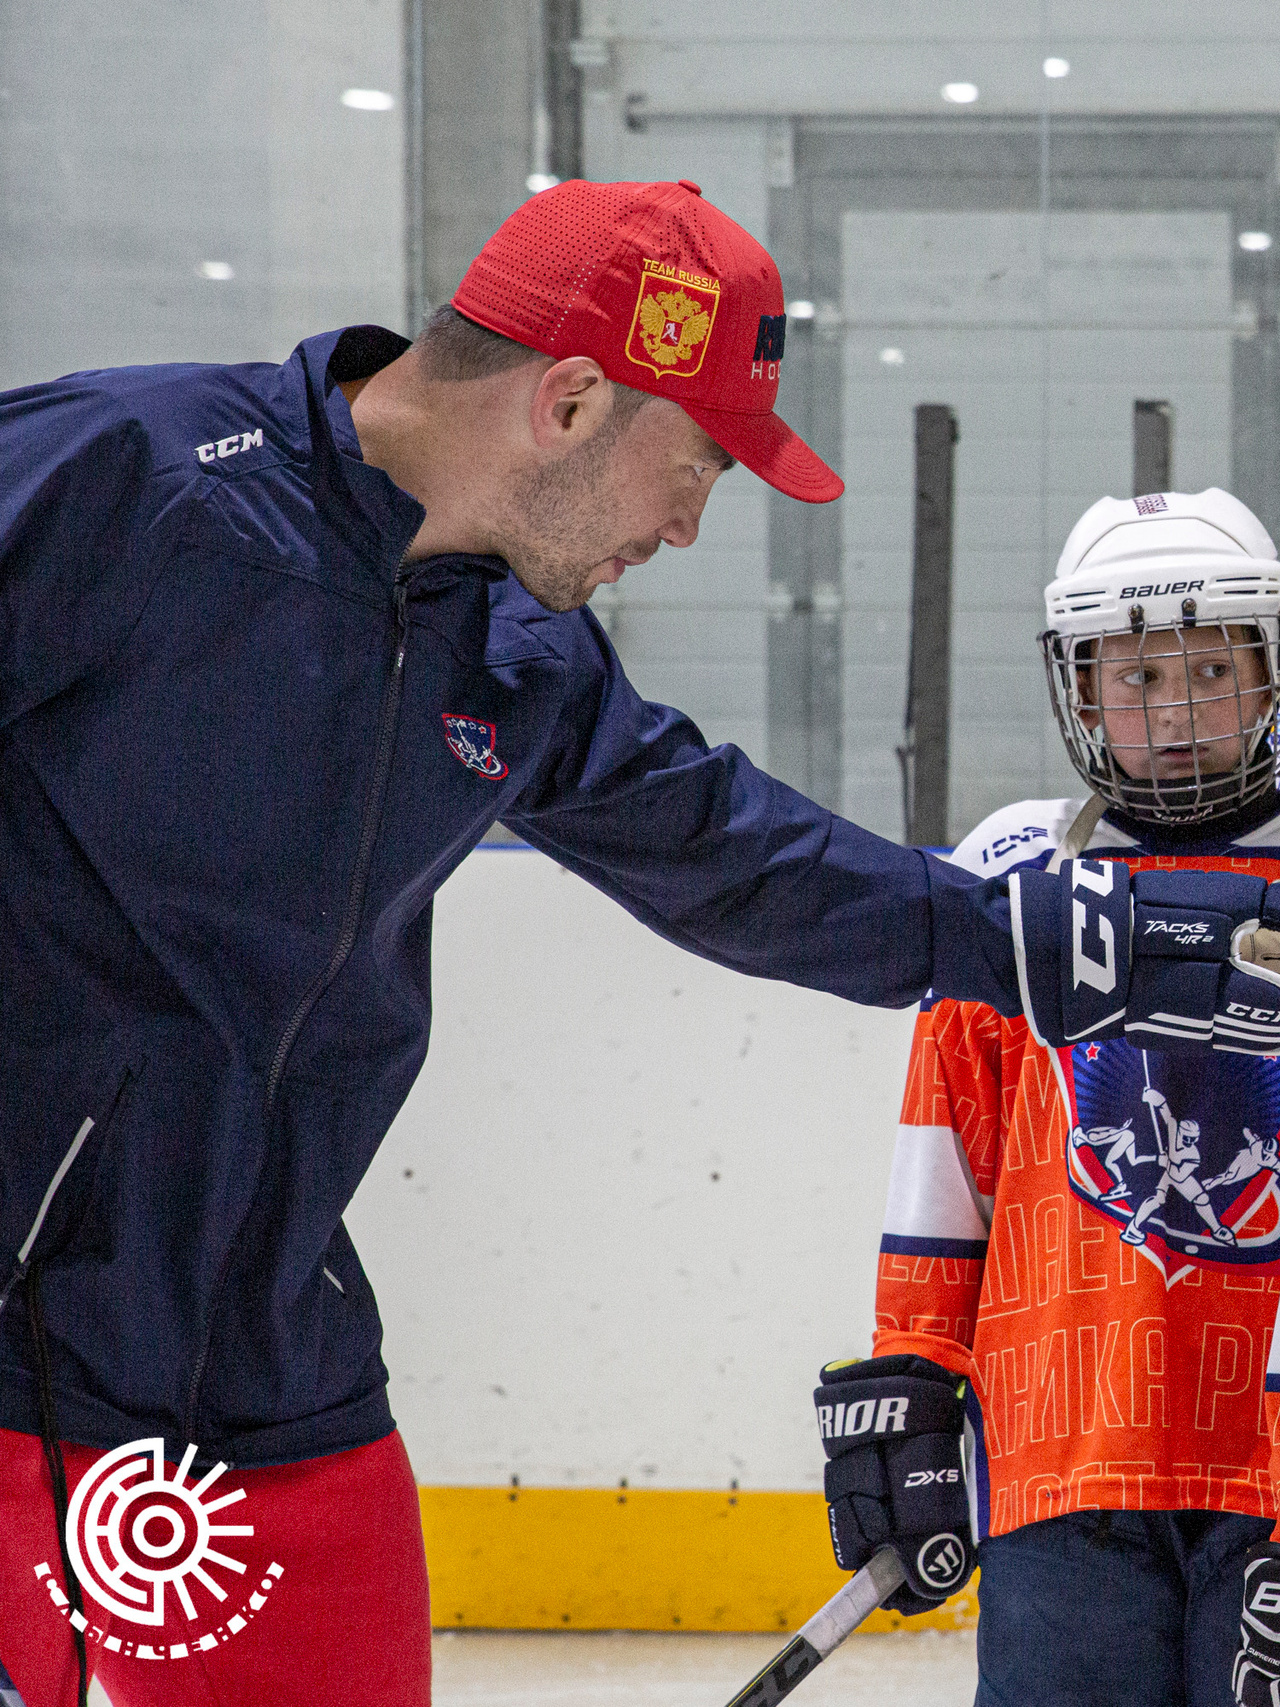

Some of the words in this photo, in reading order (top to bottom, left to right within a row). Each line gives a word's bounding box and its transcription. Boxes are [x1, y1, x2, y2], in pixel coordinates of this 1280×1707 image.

[643, 258, 676, 277] TEAM
[678, 270, 720, 290] RUSSIA
[194, 428, 263, 464] CCM
[1119, 579, 1205, 600] BAUER
[1144, 919, 1210, 936] TACKS
[1247, 1647, 1280, 1667] SUPREME
